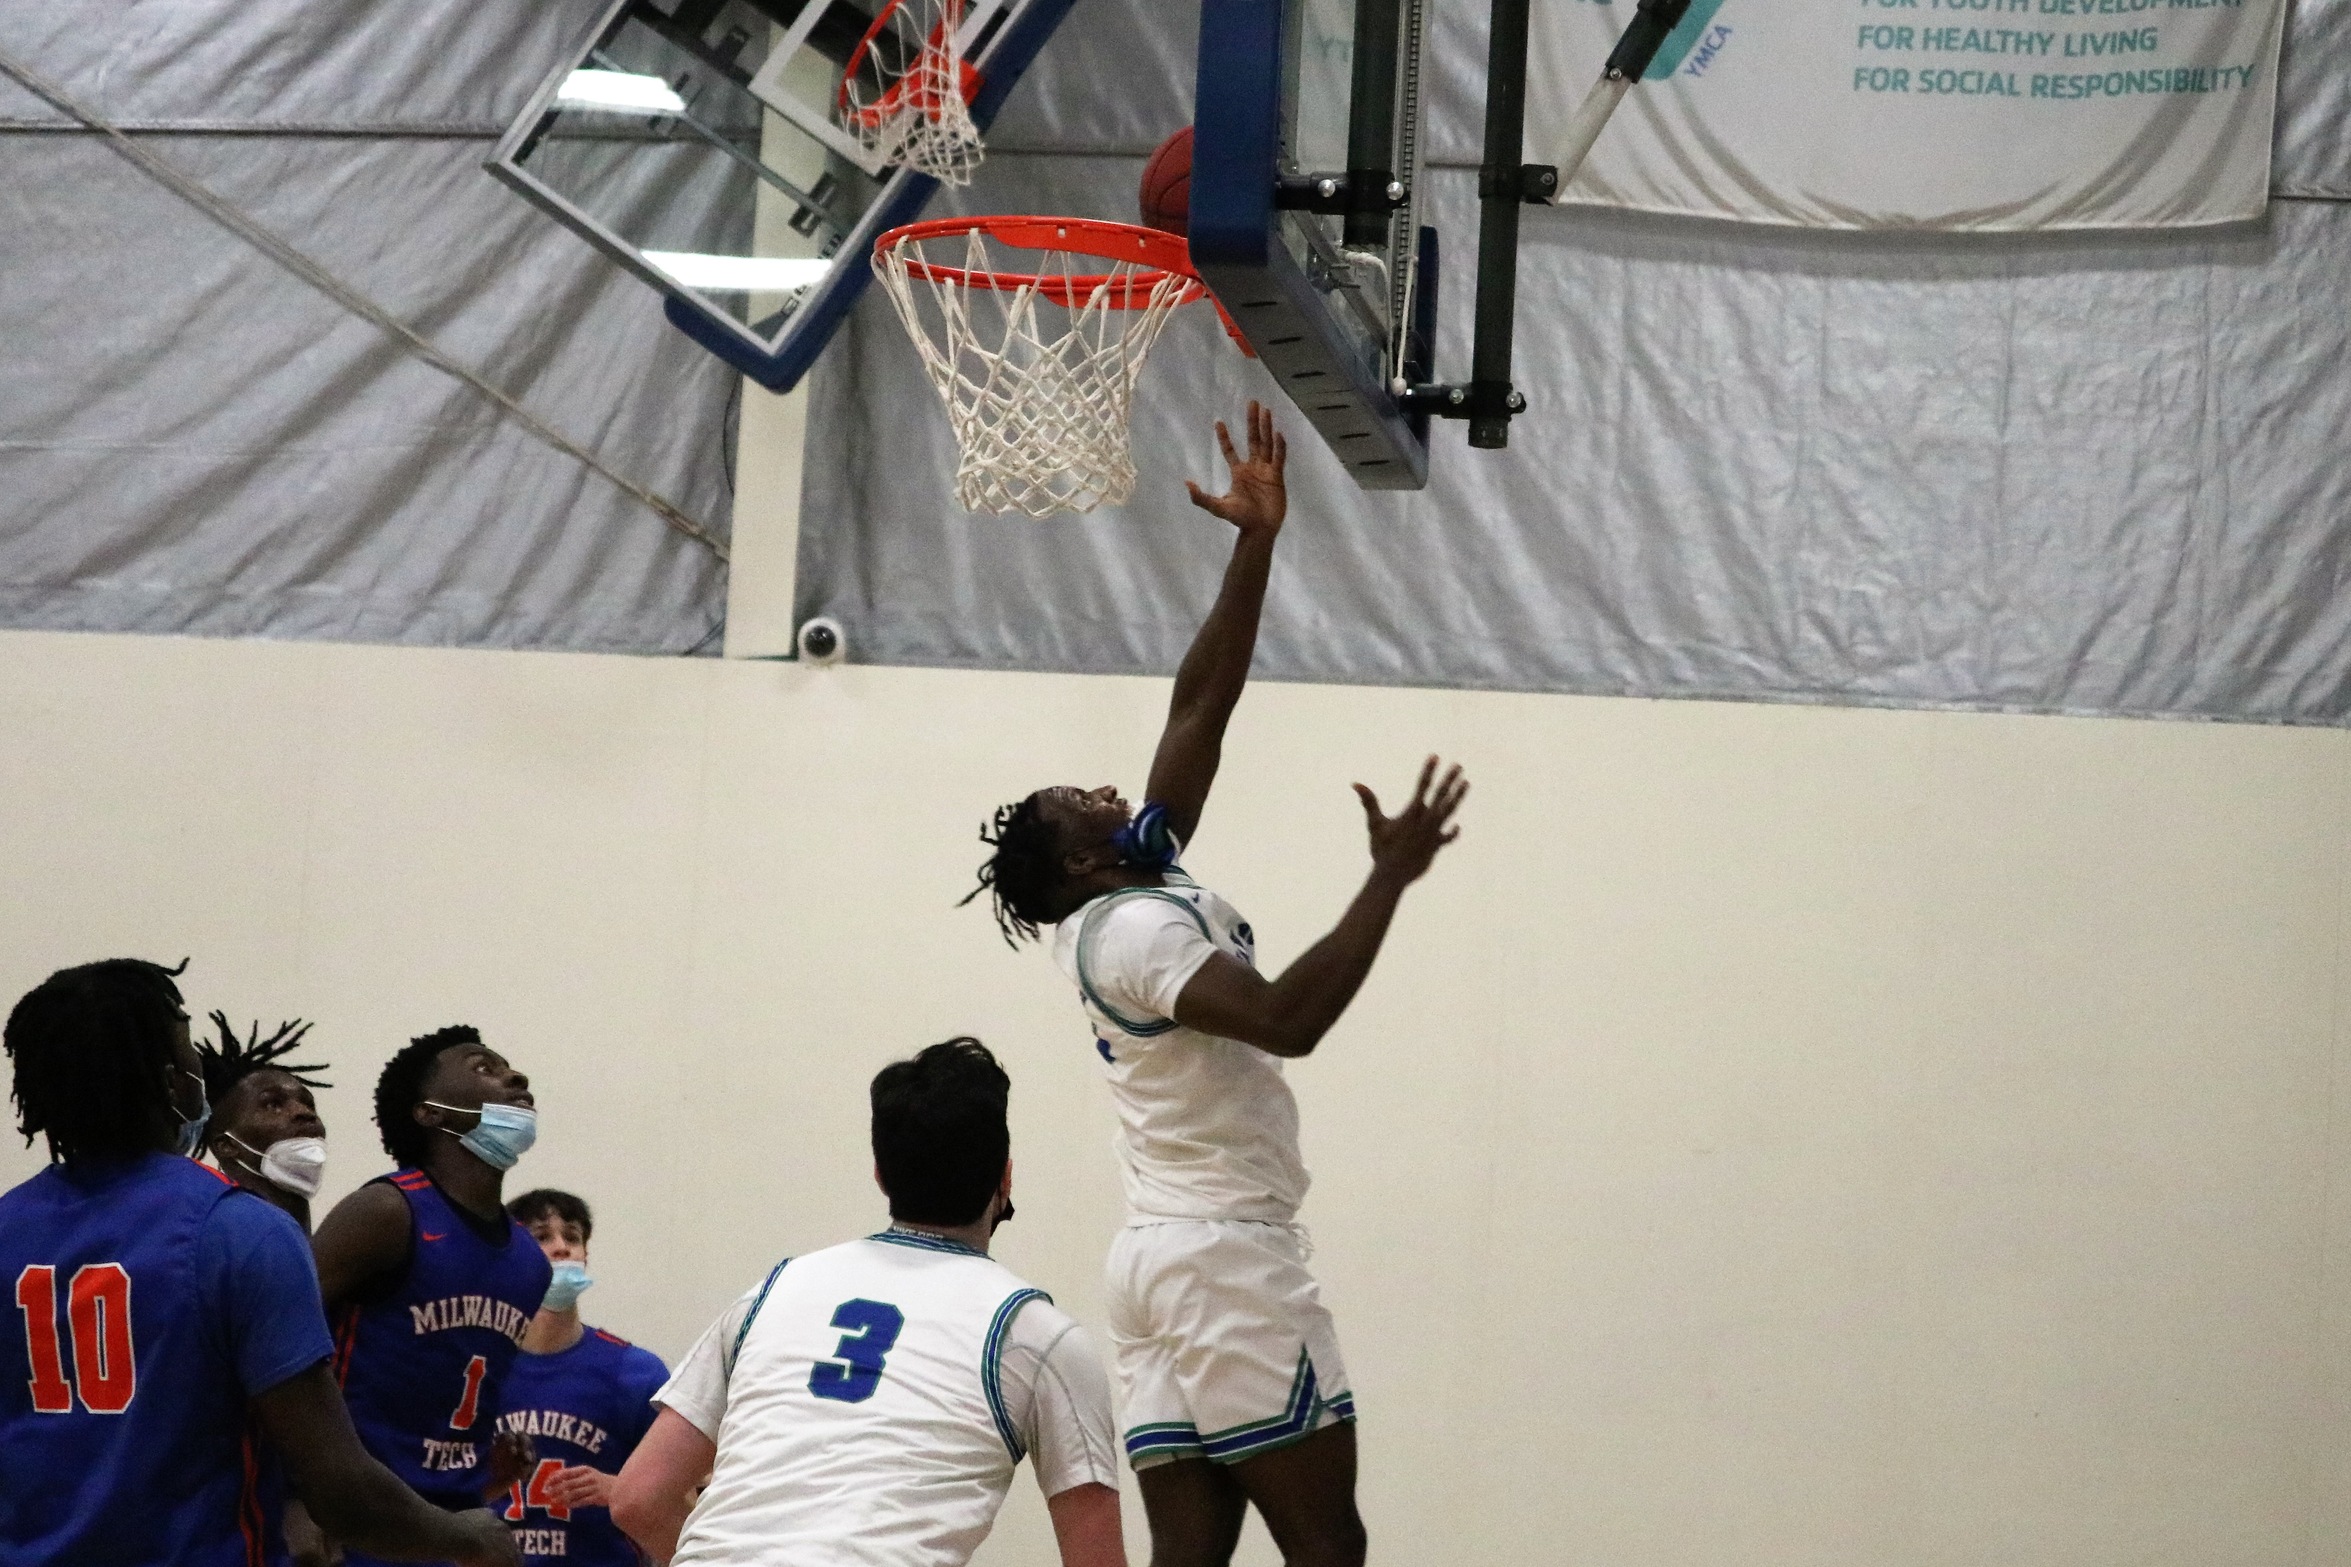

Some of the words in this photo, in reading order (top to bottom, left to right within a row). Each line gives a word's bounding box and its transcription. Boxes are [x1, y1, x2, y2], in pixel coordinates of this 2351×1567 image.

[1684, 24, 1734, 78] YMCA
[1857, 25, 1915, 50] FOR
[1922, 27, 2055, 56] HEALTHY
[2063, 26, 2158, 57] LIVING
[1853, 67, 1910, 93] FOR
[1917, 69, 2021, 97] SOCIAL
[2030, 64, 2254, 100] RESPONSIBILITY
[15, 1261, 136, 1414] 10
[806, 1297, 905, 1404] 3
[450, 1354, 487, 1430] 1
[422, 1438, 478, 1471] TECH
[511, 1529, 567, 1556] TECH
